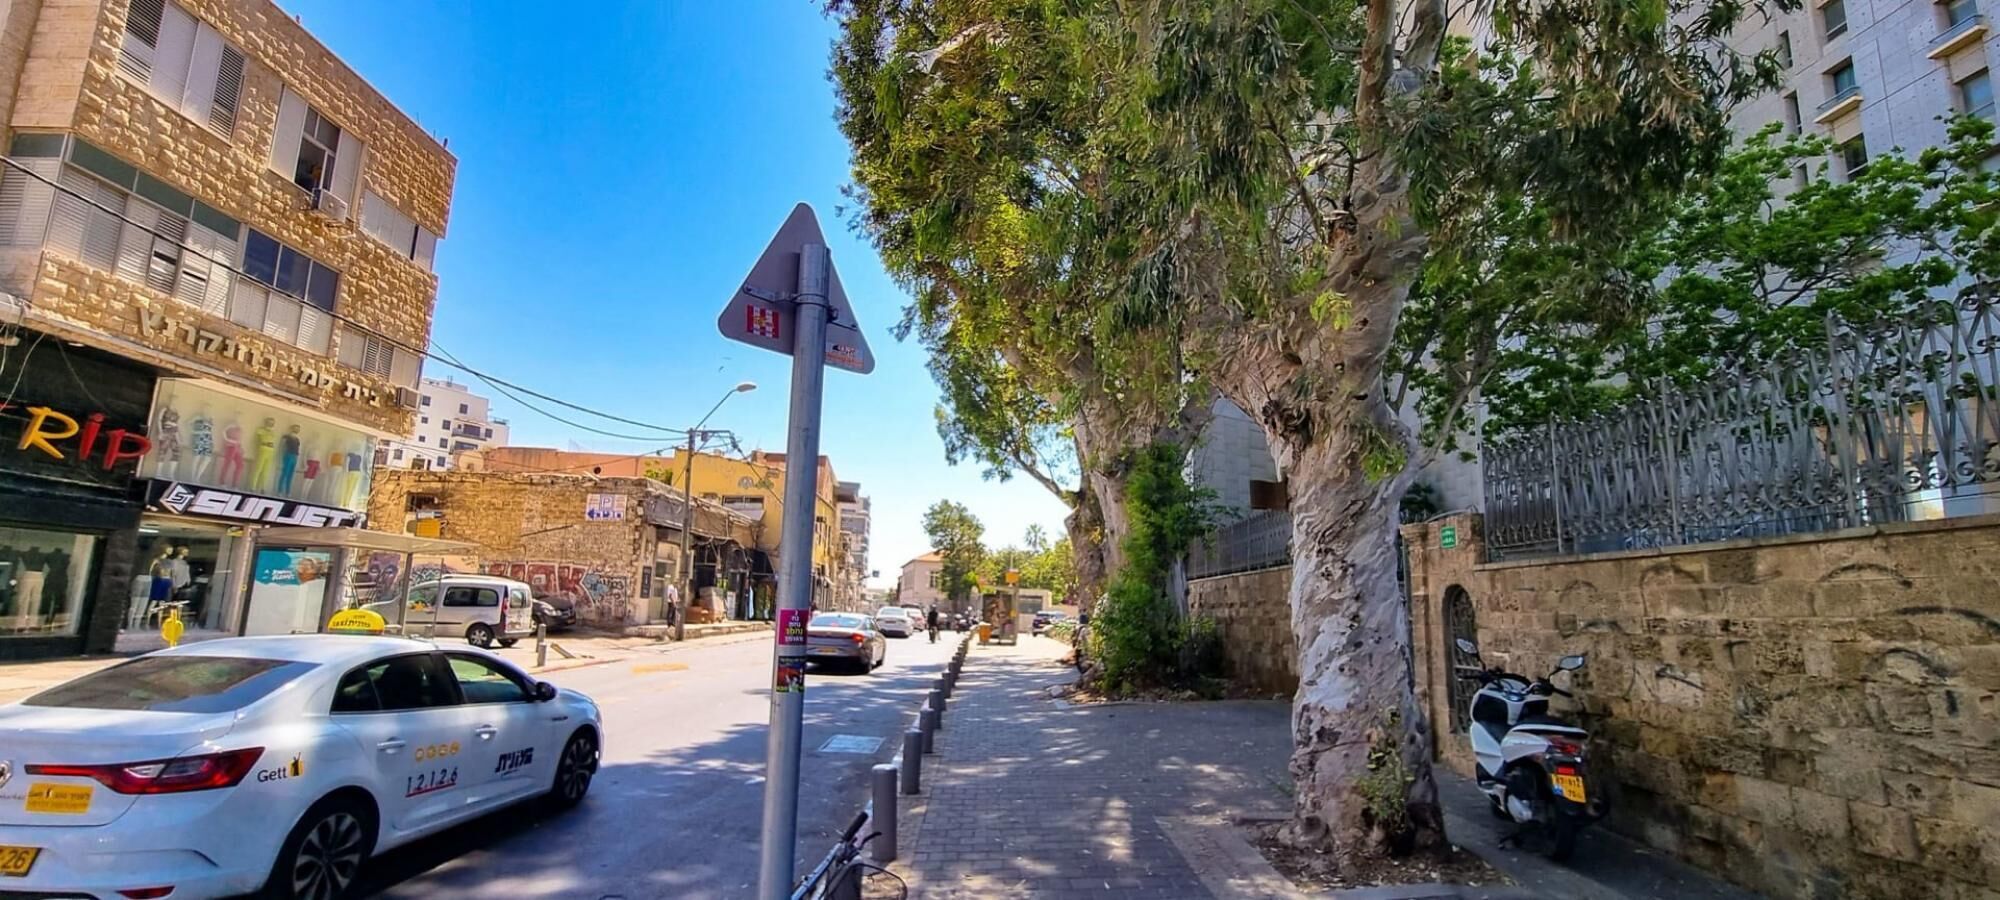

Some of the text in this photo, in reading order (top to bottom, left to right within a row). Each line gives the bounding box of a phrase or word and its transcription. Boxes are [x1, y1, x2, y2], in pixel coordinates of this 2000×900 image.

[343, 379, 381, 408] בית
[188, 489, 354, 529] SUNJET
[257, 766, 288, 782] Gett
